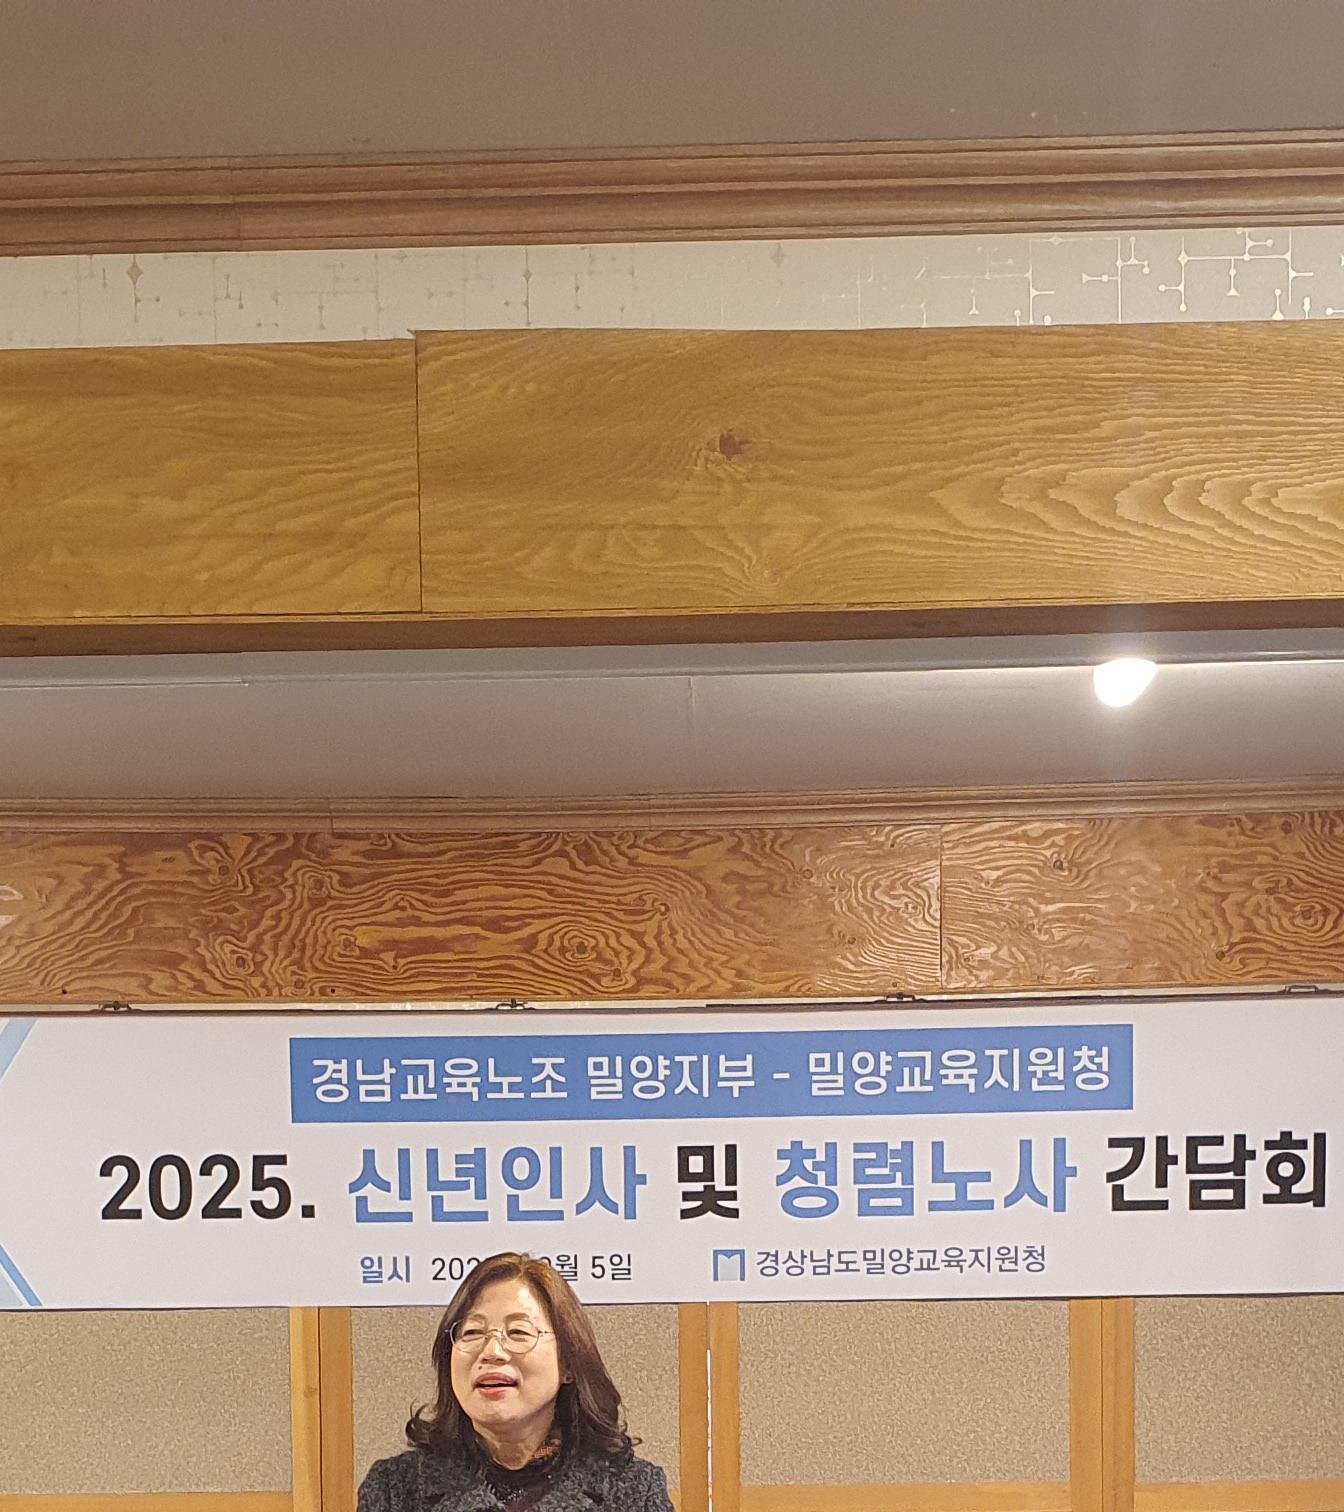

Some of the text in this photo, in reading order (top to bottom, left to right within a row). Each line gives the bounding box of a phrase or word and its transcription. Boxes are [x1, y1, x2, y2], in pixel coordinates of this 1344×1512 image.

[312, 1057, 567, 1103] 경남교육노조
[586, 1053, 755, 1100] 밀양지부
[809, 1046, 1110, 1097] 밀양교육지원청
[99, 1130, 1326, 1223] 2025. 신년인사 및 청렴노사 간담회
[360, 1255, 411, 1283] 일시
[591, 1253, 632, 1281] 5일
[756, 1245, 1046, 1277] 경상남도밀양교육지원청
